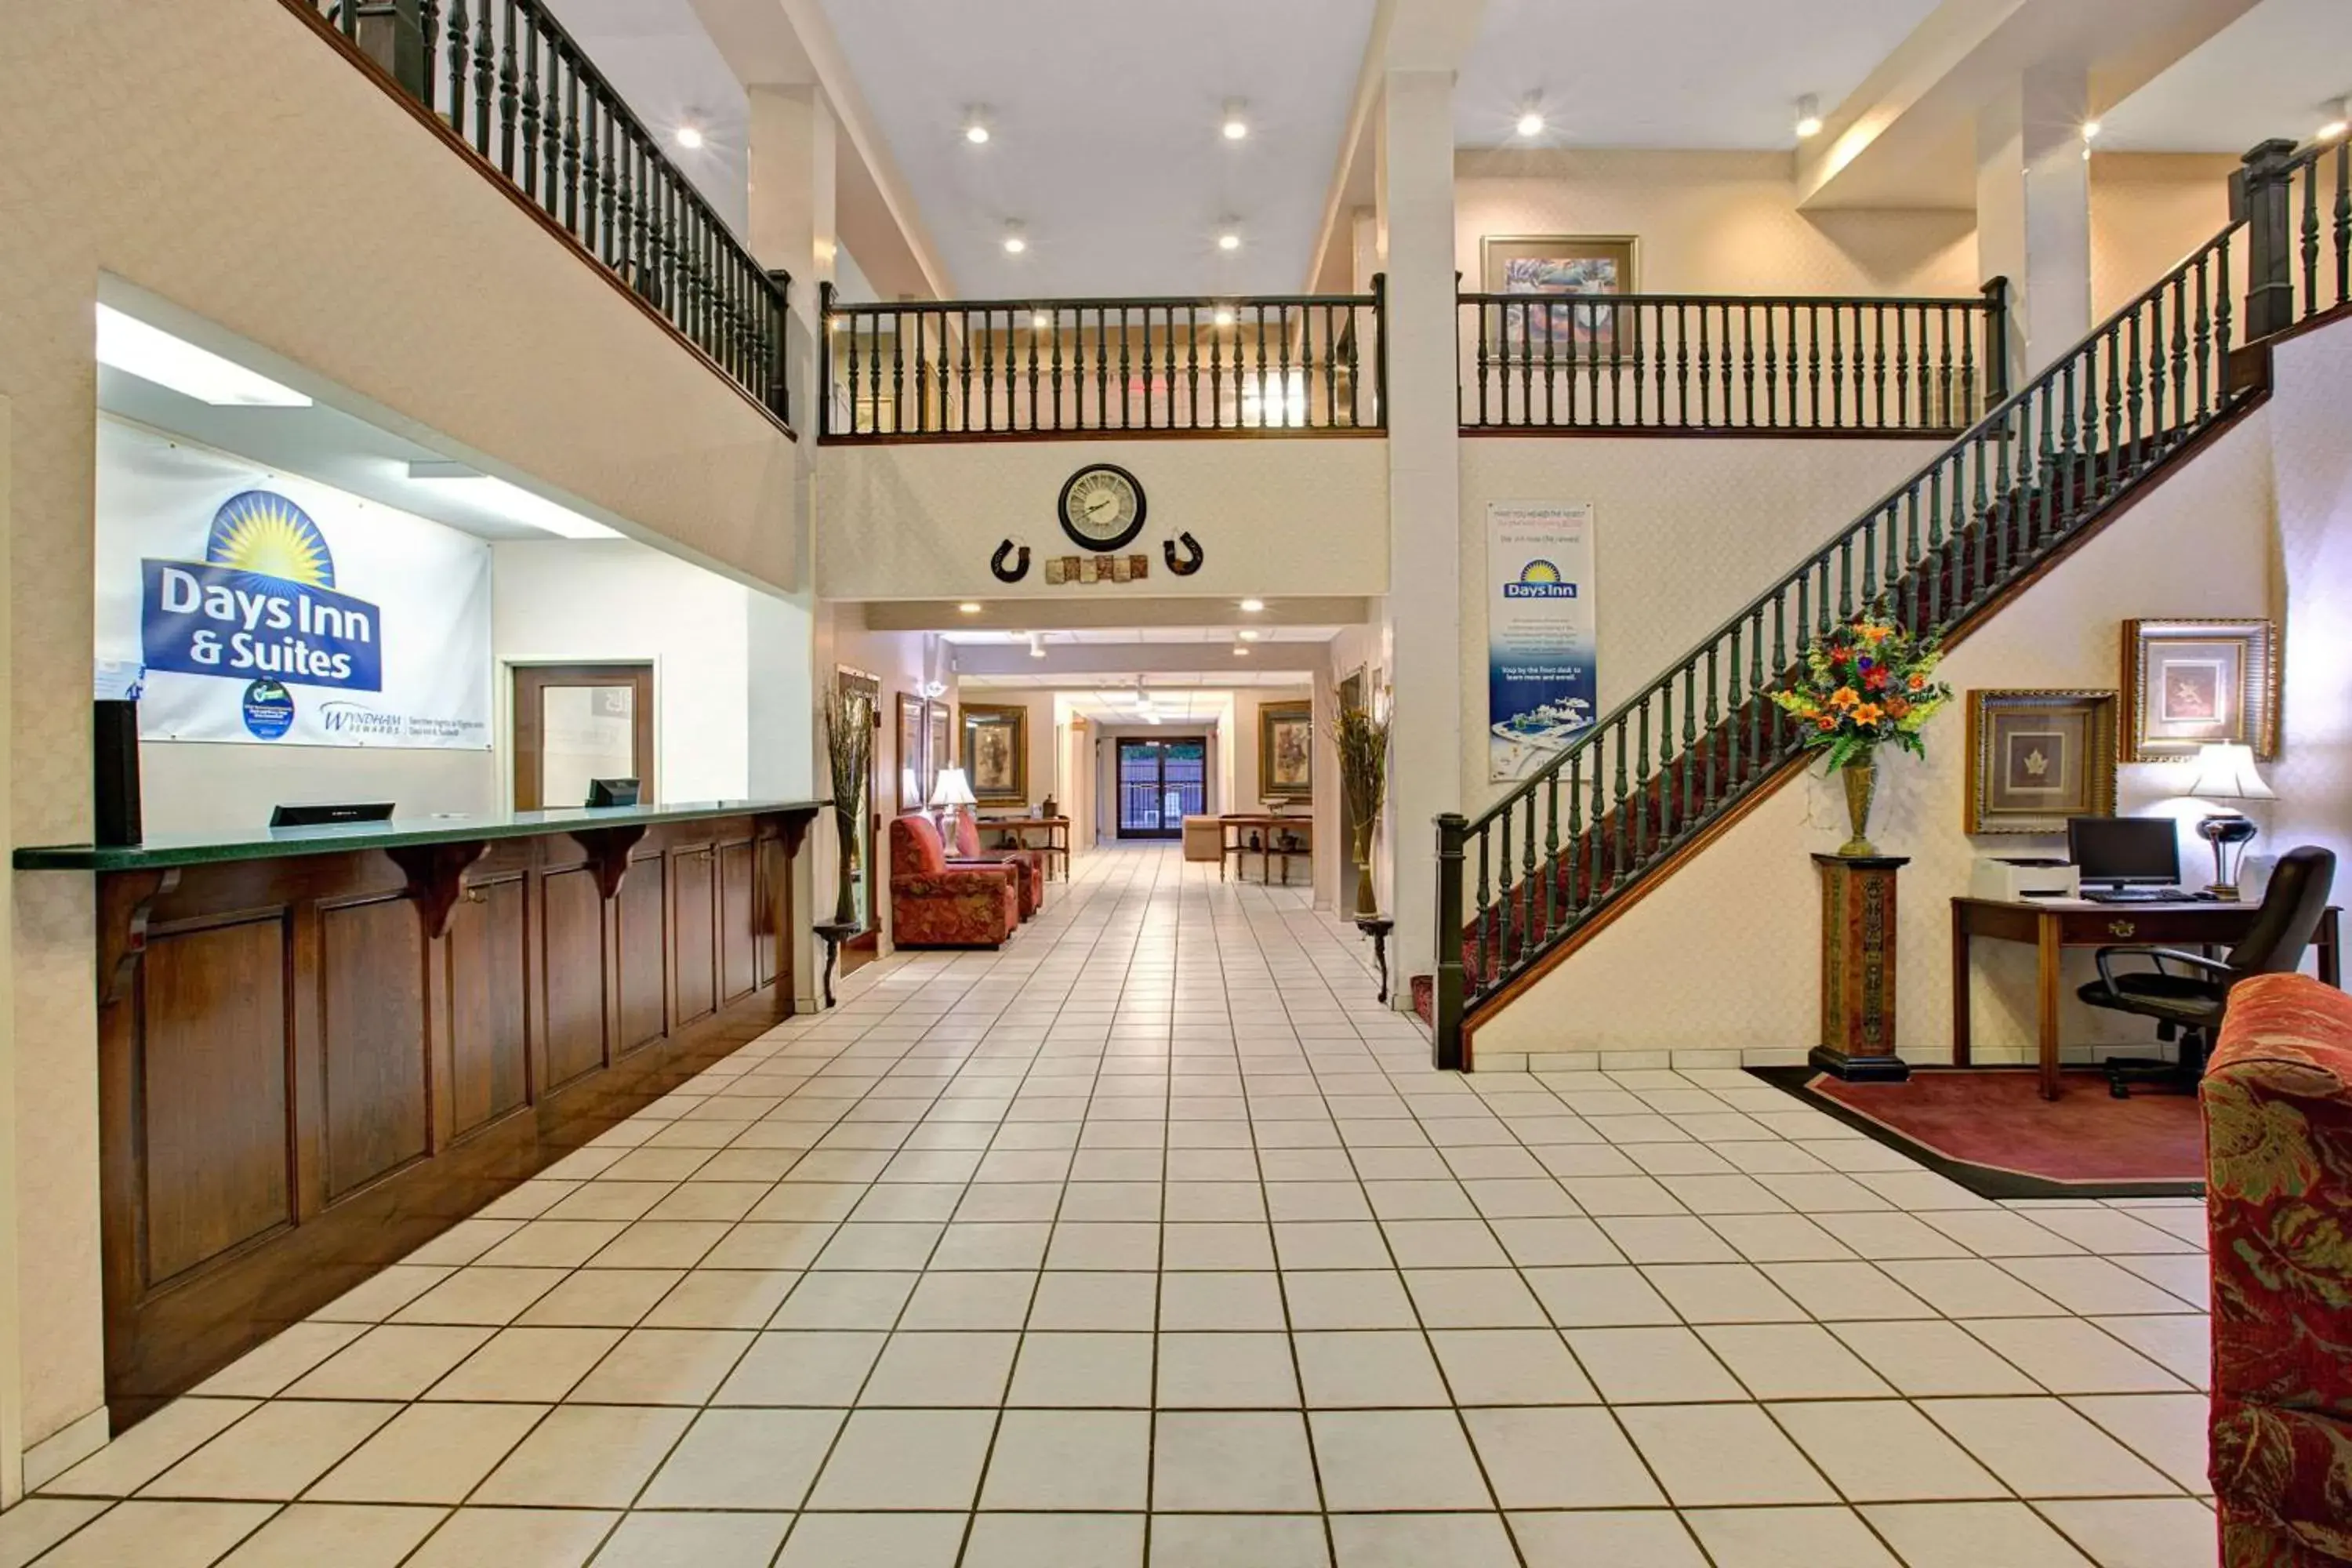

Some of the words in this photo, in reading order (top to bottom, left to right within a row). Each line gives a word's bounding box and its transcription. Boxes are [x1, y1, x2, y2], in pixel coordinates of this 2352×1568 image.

[162, 567, 292, 632] Days
[299, 593, 371, 644] Inn
[1508, 584, 1545, 597] Days
[1548, 584, 1574, 596] Inn
[191, 630, 223, 665] &
[230, 633, 352, 679] Suites
[325, 711, 401, 731] WYNDHAM
